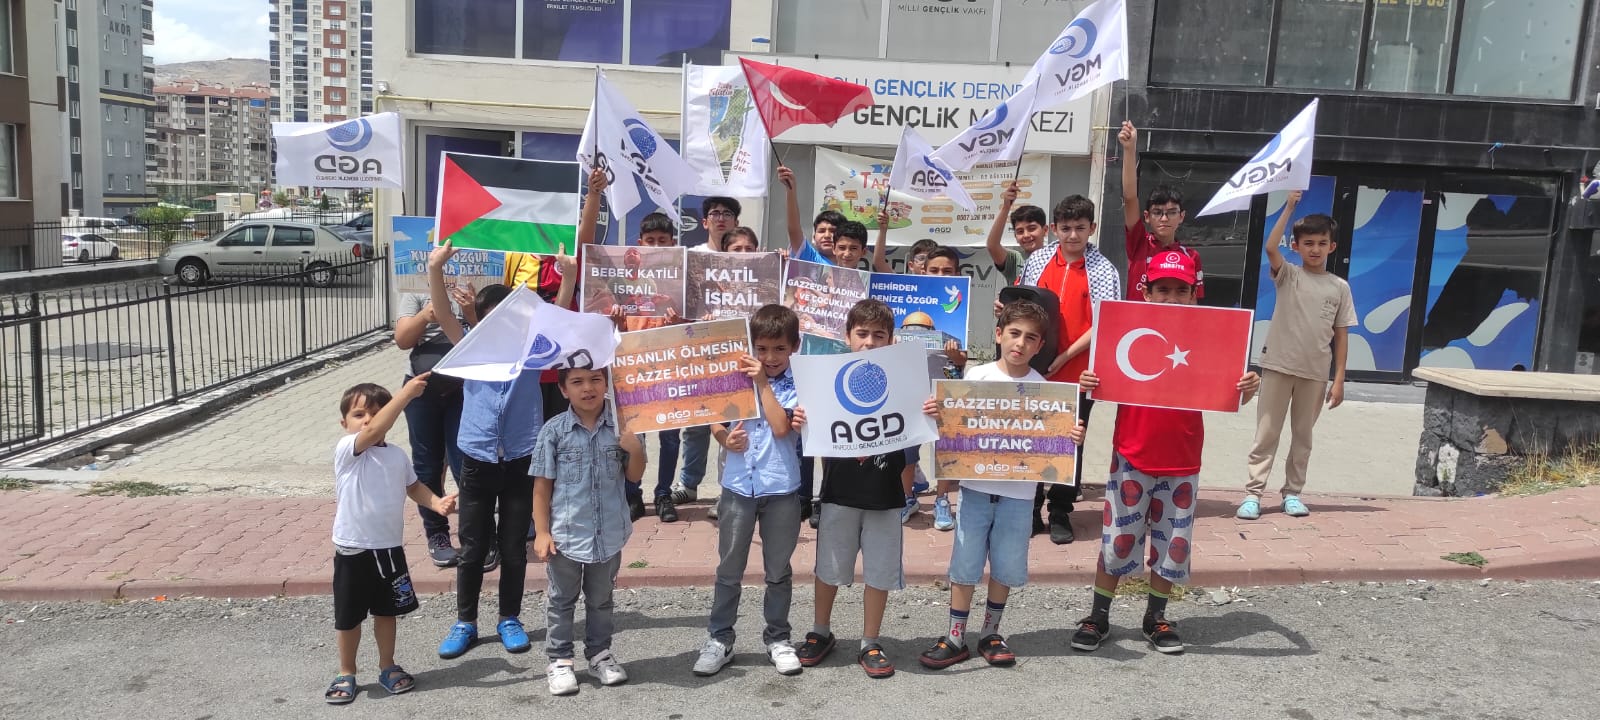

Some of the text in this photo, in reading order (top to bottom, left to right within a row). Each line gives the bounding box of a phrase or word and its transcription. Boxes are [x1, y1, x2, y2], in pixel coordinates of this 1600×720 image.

[922, 5, 960, 15] GENÇLİK
[109, 20, 131, 36] AKOR
[968, 108, 1074, 134] MKEZİ
[911, 170, 948, 187] AGD
[591, 267, 678, 279] BEBEK KATİLİ
[705, 267, 759, 283] KATİL
[614, 283, 657, 295] İSRAİL
[787, 279, 866, 299] GAZZE'DE KADINLA
[871, 281, 918, 292] NEHİRDEN
[705, 288, 763, 306] İSRAİL
[800, 293, 811, 301] VE
[905, 294, 939, 305] ÖZGÜR
[680, 340, 748, 359] ÖLMESİN,
[625, 360, 739, 385] GAZZE İÇİN DUR
[943, 397, 1071, 413] GAZZE'DE İŞGAL
[667, 410, 690, 419] AGD
[831, 412, 905, 443] AGD
[967, 416, 1046, 431] DÜNYADA
[978, 438, 1033, 452] UTANÇ
[986, 463, 1010, 472] AGD
